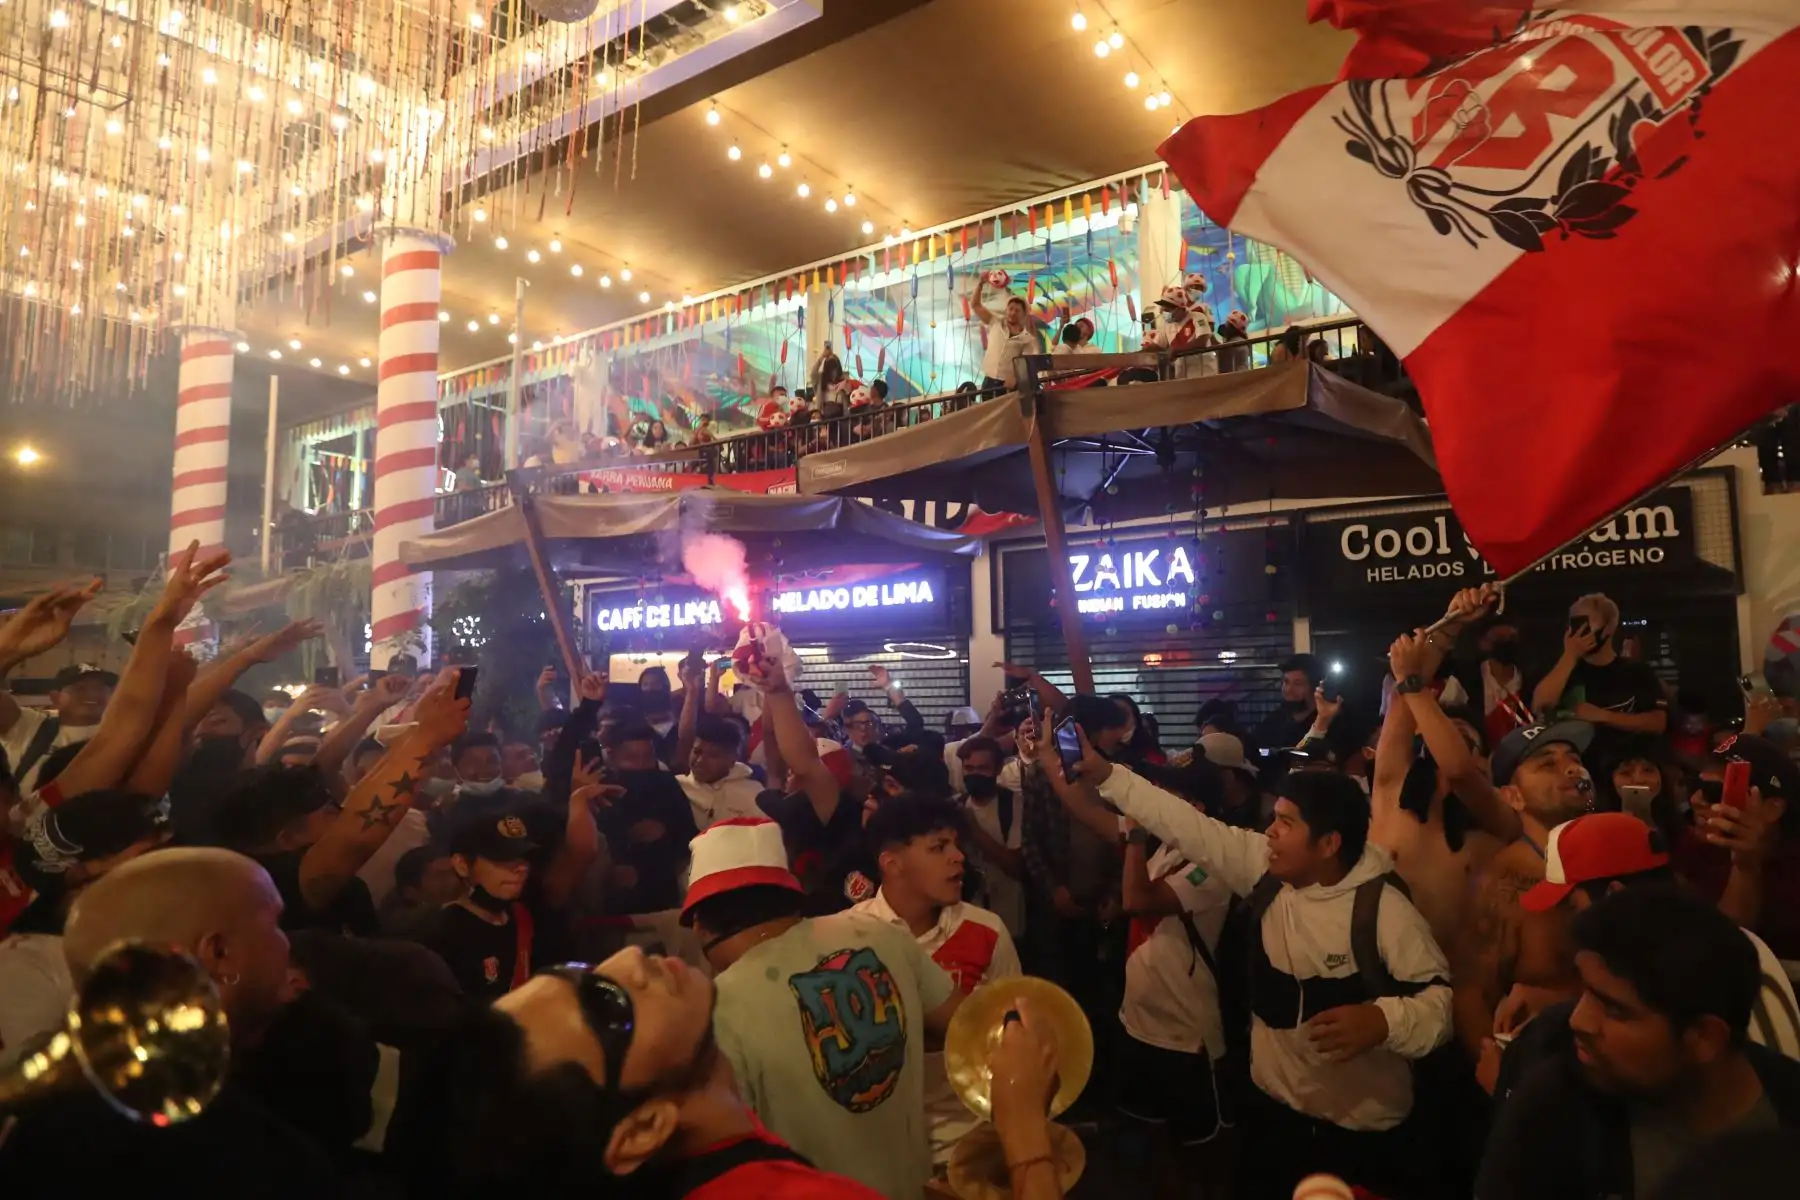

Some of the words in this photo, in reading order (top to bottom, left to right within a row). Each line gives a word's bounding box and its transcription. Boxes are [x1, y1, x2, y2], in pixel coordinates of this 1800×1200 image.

[625, 474, 673, 489] PERUANA
[1341, 516, 1451, 561] Cool
[1070, 547, 1195, 592] ZAIKA
[1367, 561, 1465, 582] HELADOS
[1535, 547, 1665, 571] TRÓGENO
[772, 588, 850, 613] HELADO
[852, 585, 879, 608] DE
[881, 580, 934, 606] LIMA
[1132, 592, 1186, 610] FUSION
[645, 604, 671, 628] DE
[673, 600, 722, 626] LIMA
